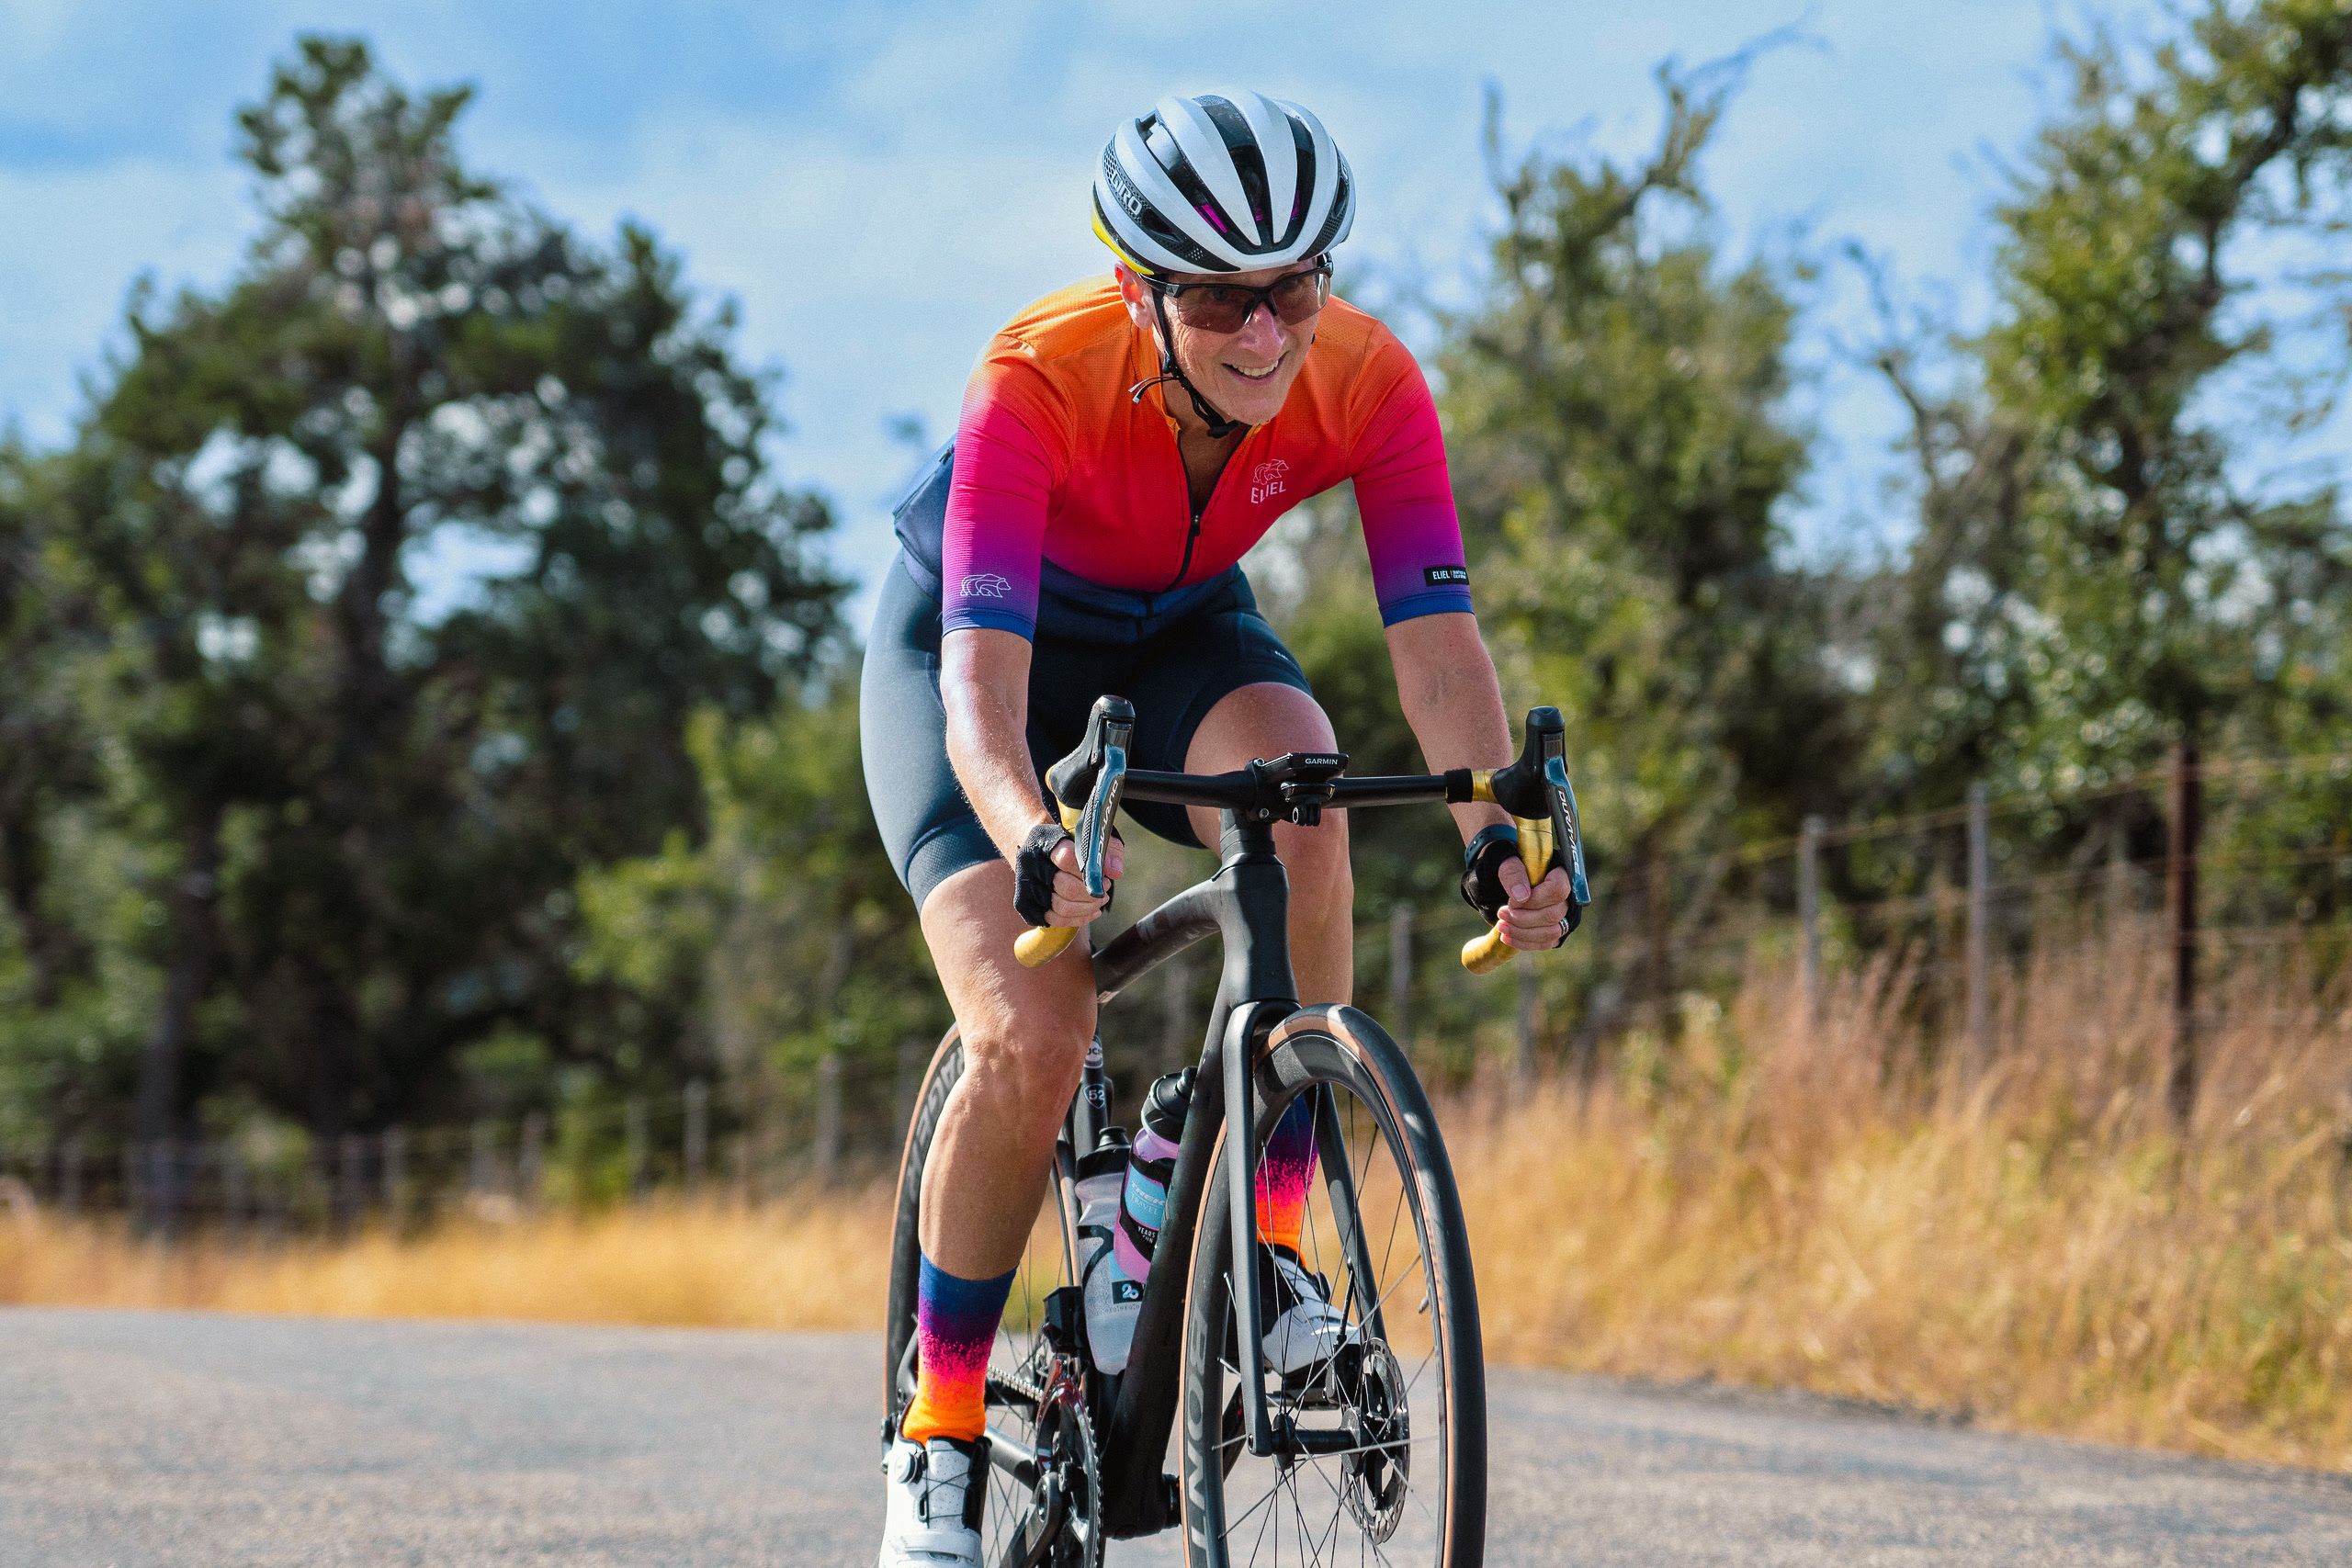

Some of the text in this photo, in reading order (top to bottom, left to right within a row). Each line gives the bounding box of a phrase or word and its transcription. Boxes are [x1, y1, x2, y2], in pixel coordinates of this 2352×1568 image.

[1111, 171, 1142, 215] GIRO
[1250, 480, 1287, 504] ELIEL
[1432, 570, 1451, 581] ELIEL
[1305, 757, 1339, 765] GARMIN
[1558, 790, 1581, 875] DURA-ACE
[1089, 1089, 1105, 1100] 52
